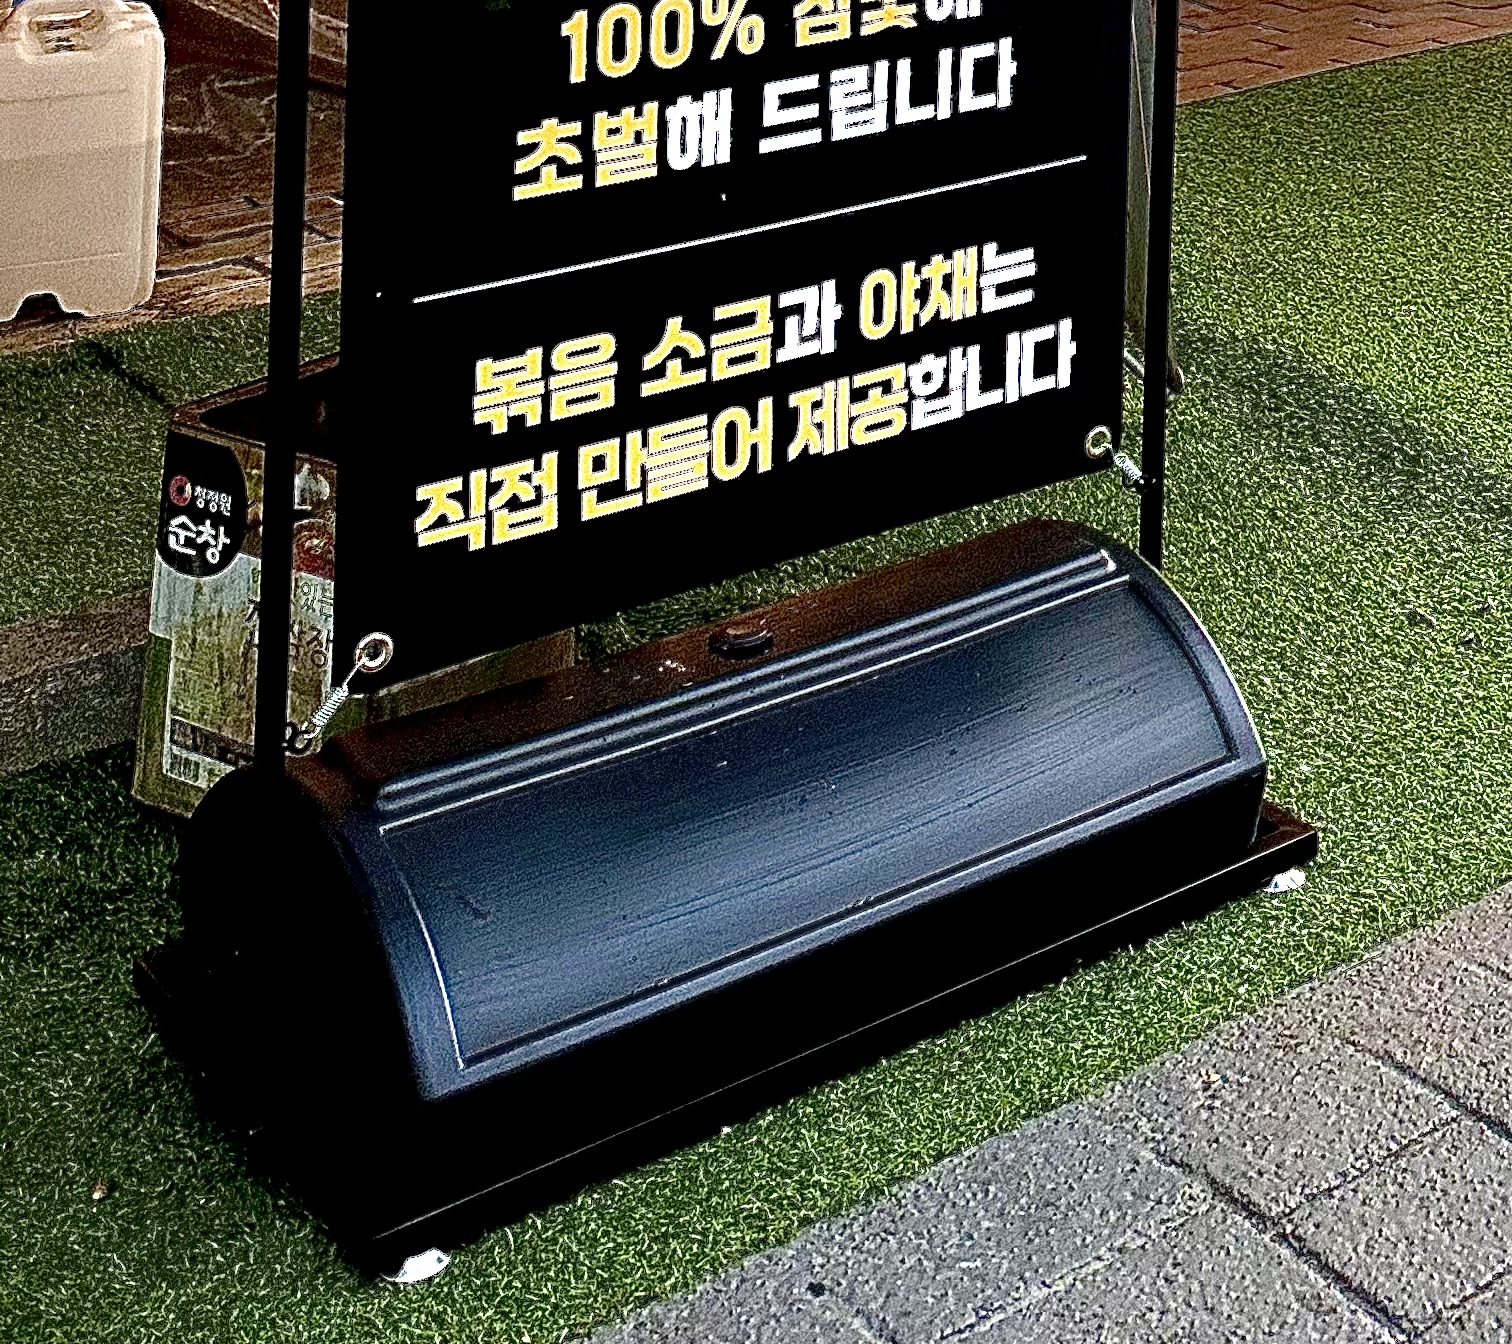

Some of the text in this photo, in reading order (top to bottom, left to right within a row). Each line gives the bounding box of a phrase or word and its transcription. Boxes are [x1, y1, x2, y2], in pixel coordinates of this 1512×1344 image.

[511, 36, 1017, 201] 초벌해 드립니다
[472, 241, 1037, 436] 볶음 소금과 야채는
[194, 485, 232, 517] 청정원
[413, 316, 1078, 551] 직접 만들어 제공합니다
[168, 514, 230, 565] 순창
